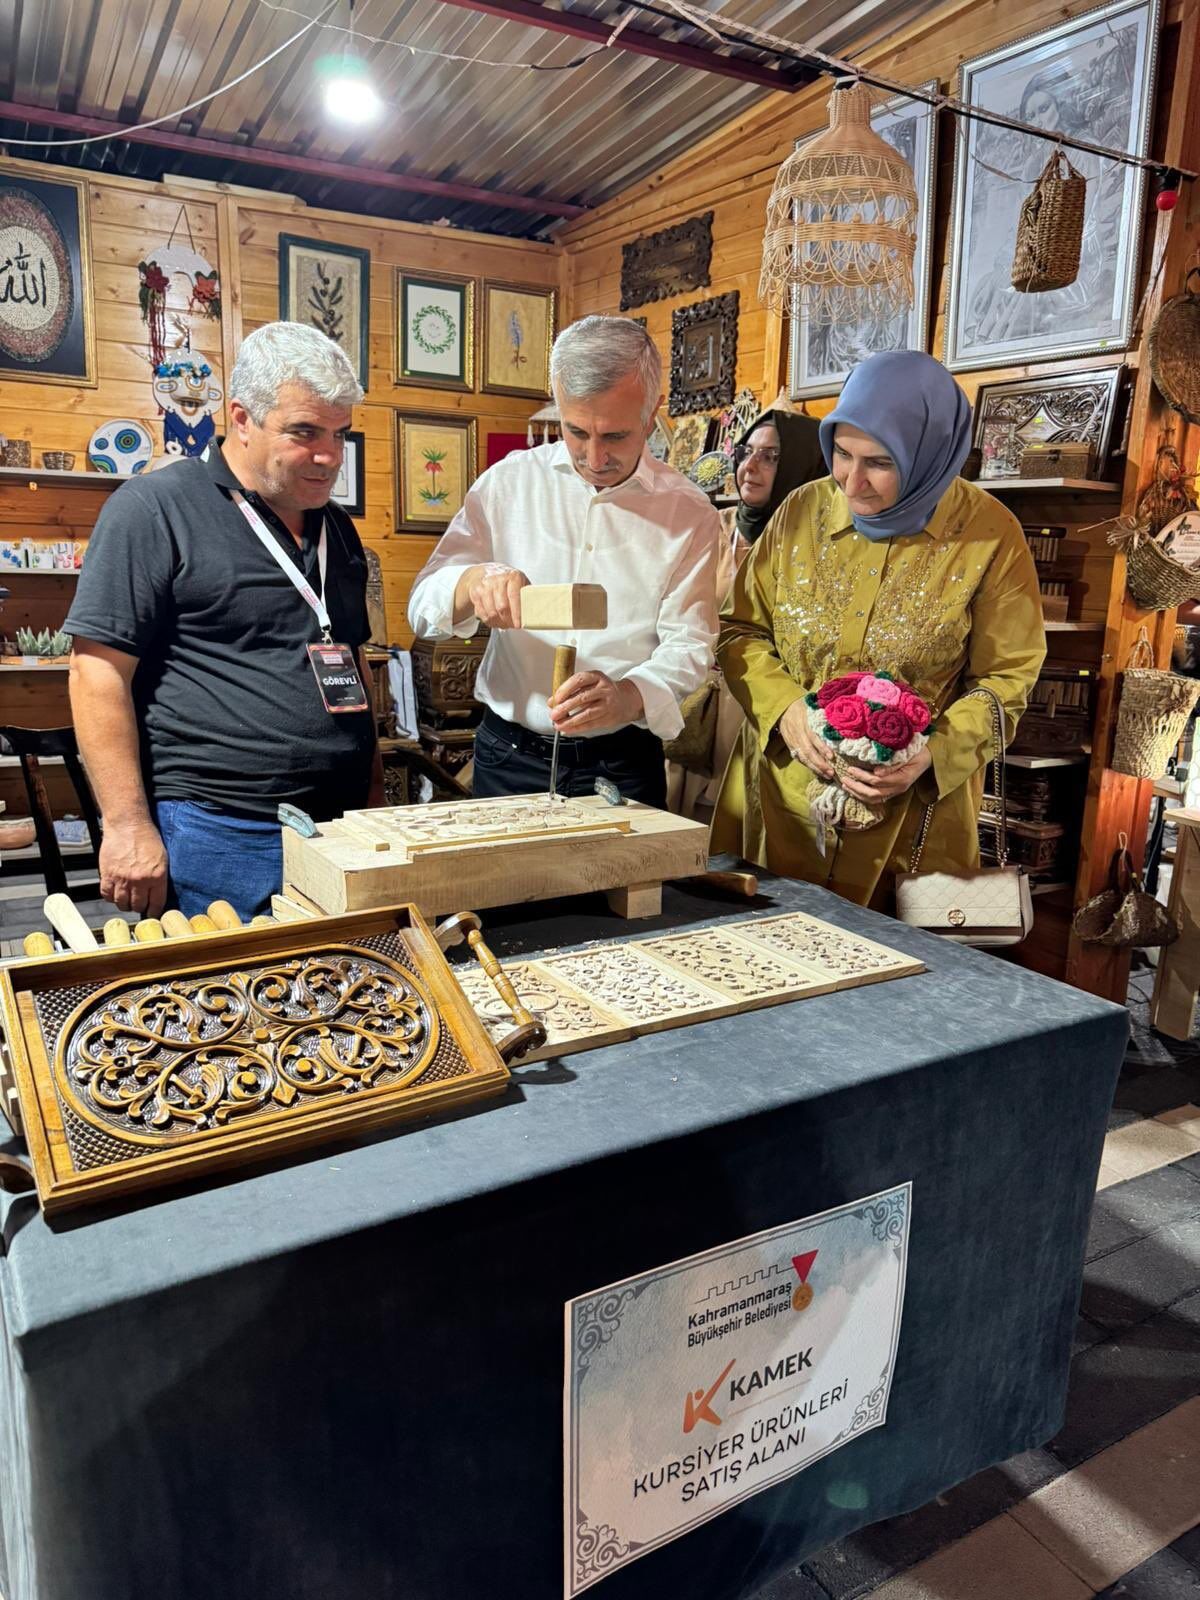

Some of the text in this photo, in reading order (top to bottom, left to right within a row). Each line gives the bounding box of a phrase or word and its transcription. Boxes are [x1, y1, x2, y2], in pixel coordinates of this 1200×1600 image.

[687, 1296, 791, 1348] Büyükşehir Belediyesi
[688, 1281, 792, 1329] Kahramanmaraş
[729, 1347, 813, 1401] KAMEK
[633, 1378, 849, 1498] KURSİYER ÜRÜNLERİ
[681, 1426, 806, 1502] SATIŞ ALANI
